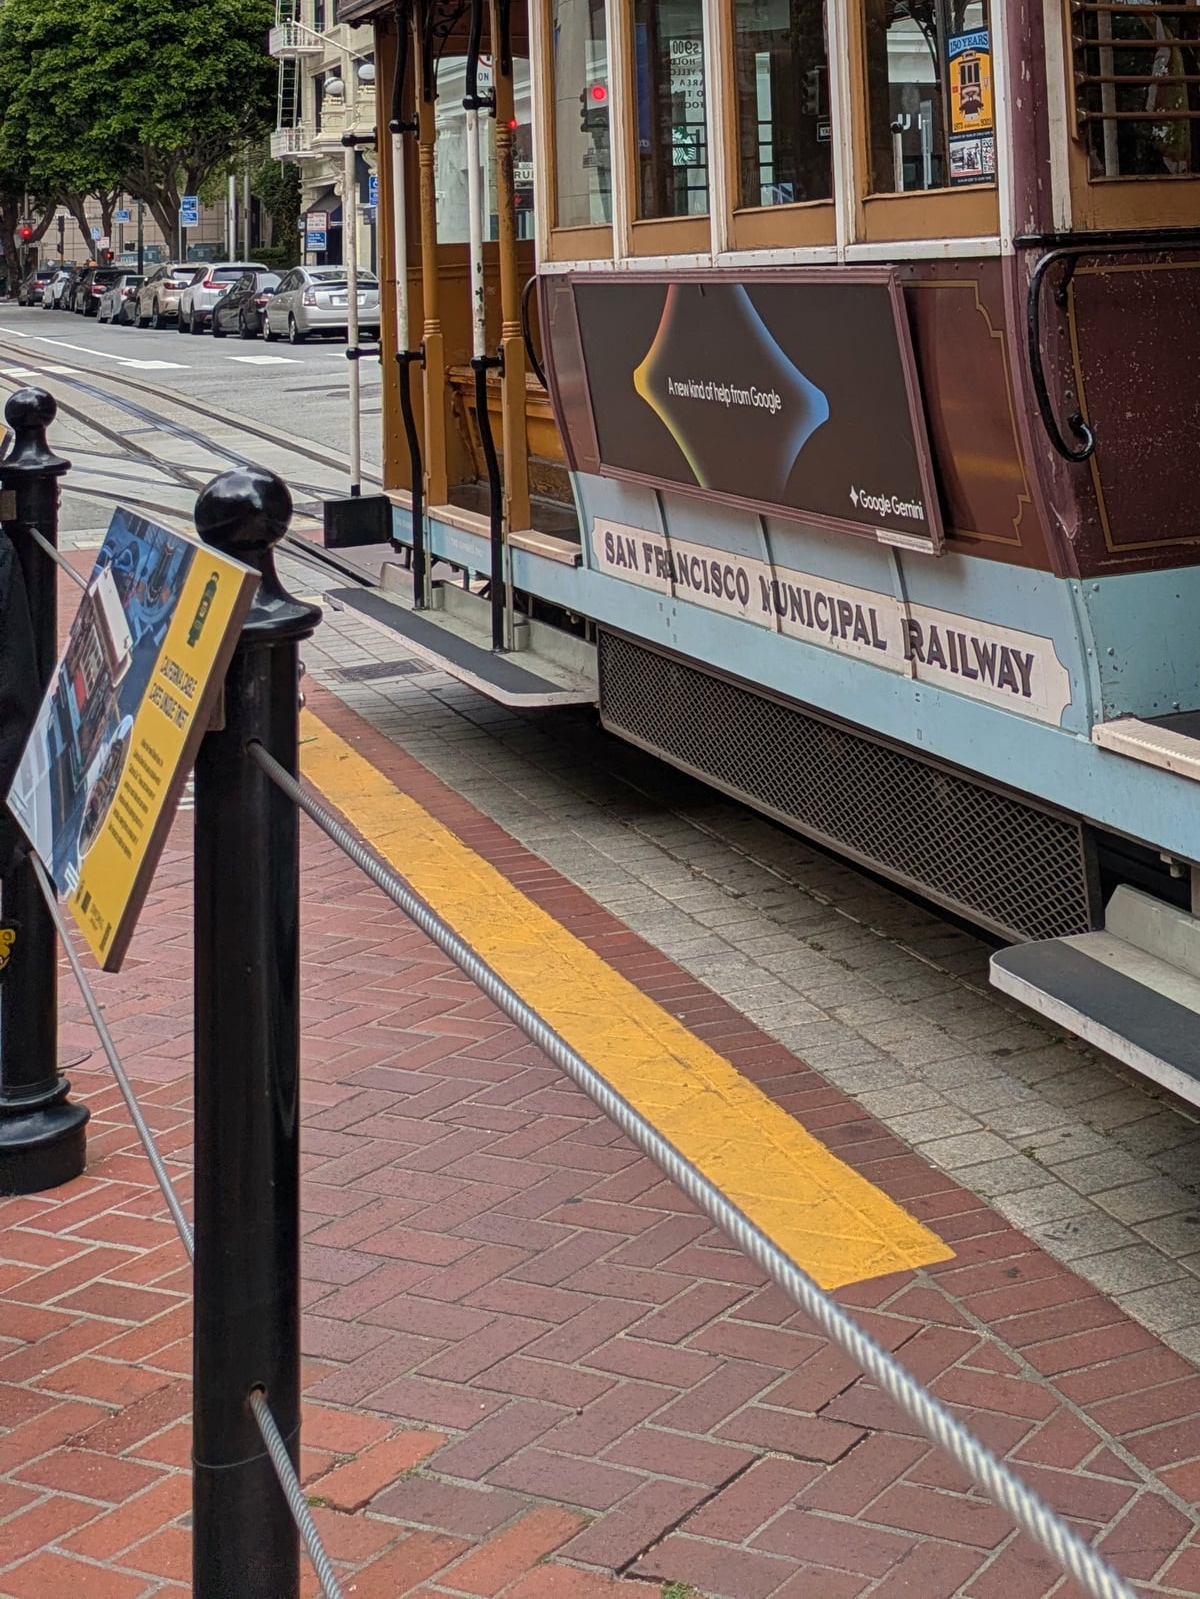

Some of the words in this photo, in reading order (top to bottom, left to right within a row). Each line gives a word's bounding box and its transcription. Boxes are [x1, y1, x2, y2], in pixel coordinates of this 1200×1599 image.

[949, 39, 961, 52] 150
[961, 34, 988, 47] YEARS
[668, 377, 674, 395] A
[674, 381, 689, 396] new
[689, 379, 705, 400] kind
[705, 382, 713, 400] of
[713, 383, 730, 407] help
[730, 384, 750, 405] from
[750, 386, 782, 414] Google
[859, 489, 891, 517] Google
[891, 496, 924, 520] Gemini
[604, 531, 639, 571] SAN
[642, 541, 750, 606] FRANCISCO
[900, 617, 1035, 698] RAILWAY
